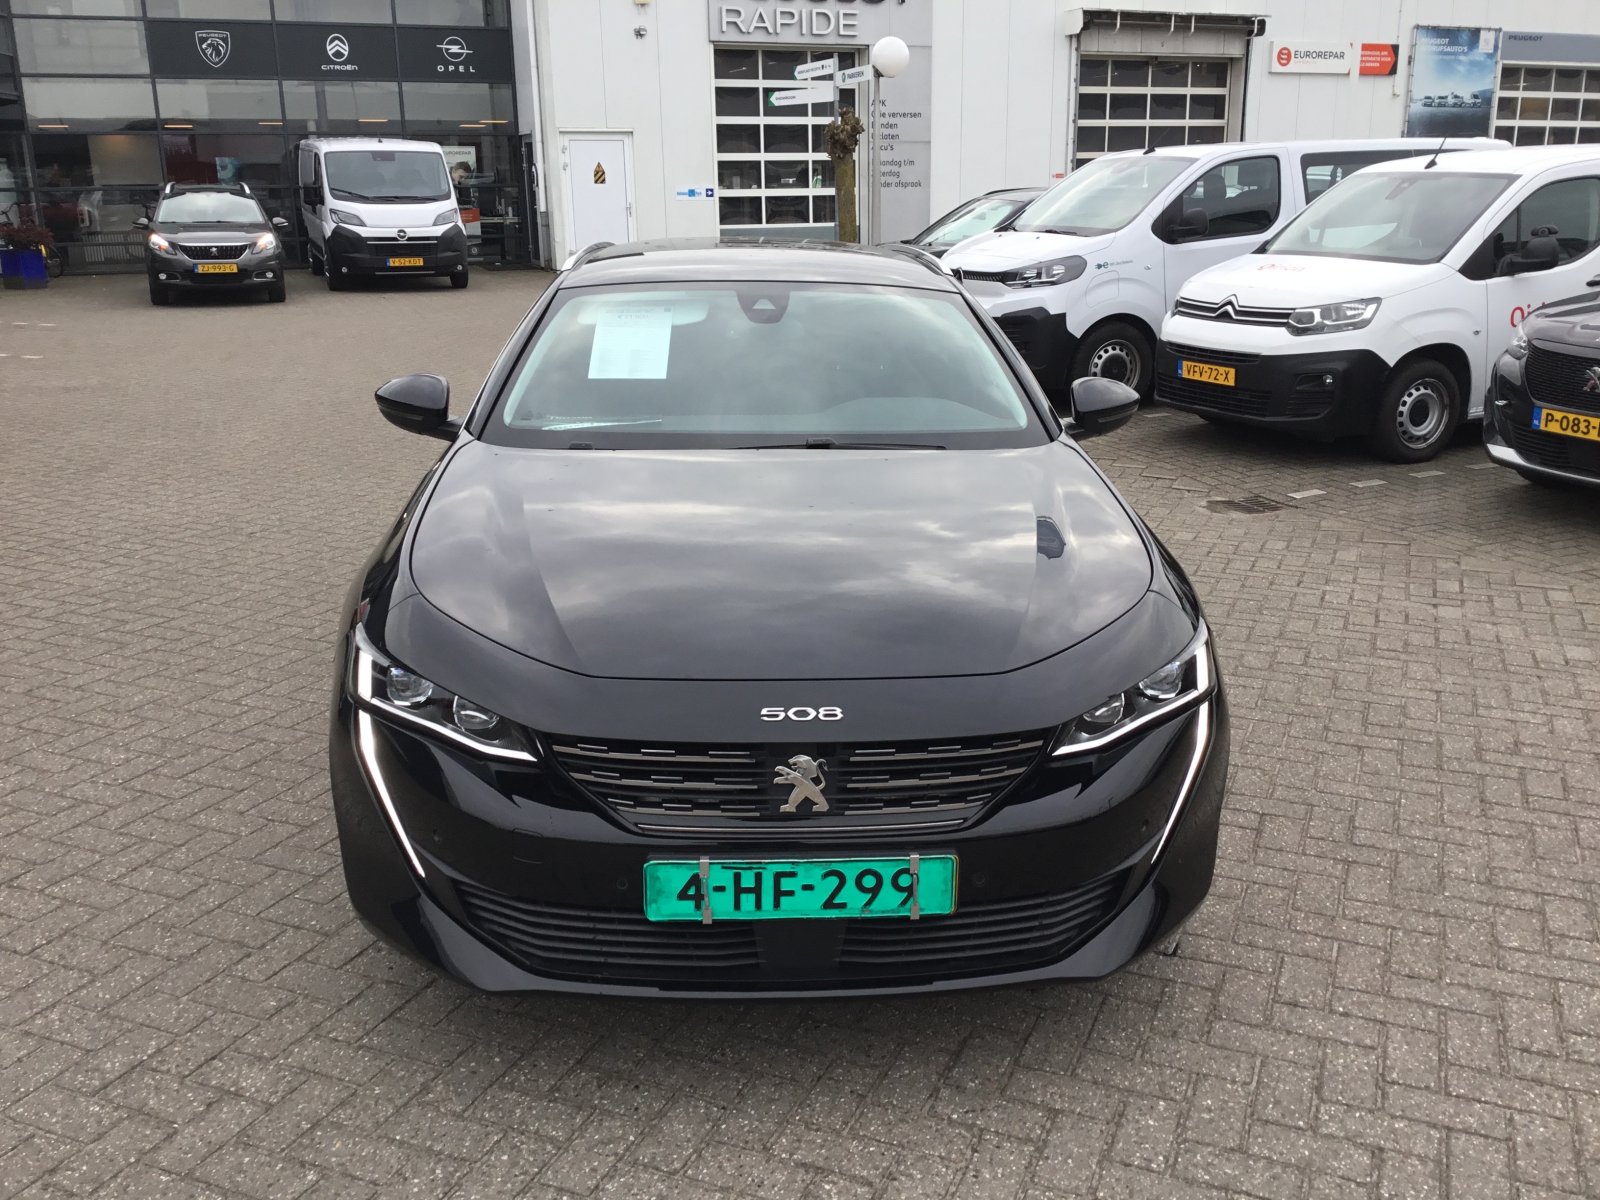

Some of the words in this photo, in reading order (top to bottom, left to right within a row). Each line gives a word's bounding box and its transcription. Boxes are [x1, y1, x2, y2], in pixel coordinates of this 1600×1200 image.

[720, 6, 860, 36] RAPIDE
[1508, 34, 1544, 42] PEUGEOT
[1293, 50, 1345, 60] EUROREPAR
[894, 180, 922, 188] afspraak
[201, 264, 235, 272] ZJ-993-G
[1186, 363, 1230, 383] VFV-72-X
[1544, 411, 1600, 439] P-083-
[760, 706, 844, 721] 508
[676, 867, 920, 912] 4-HF-299
